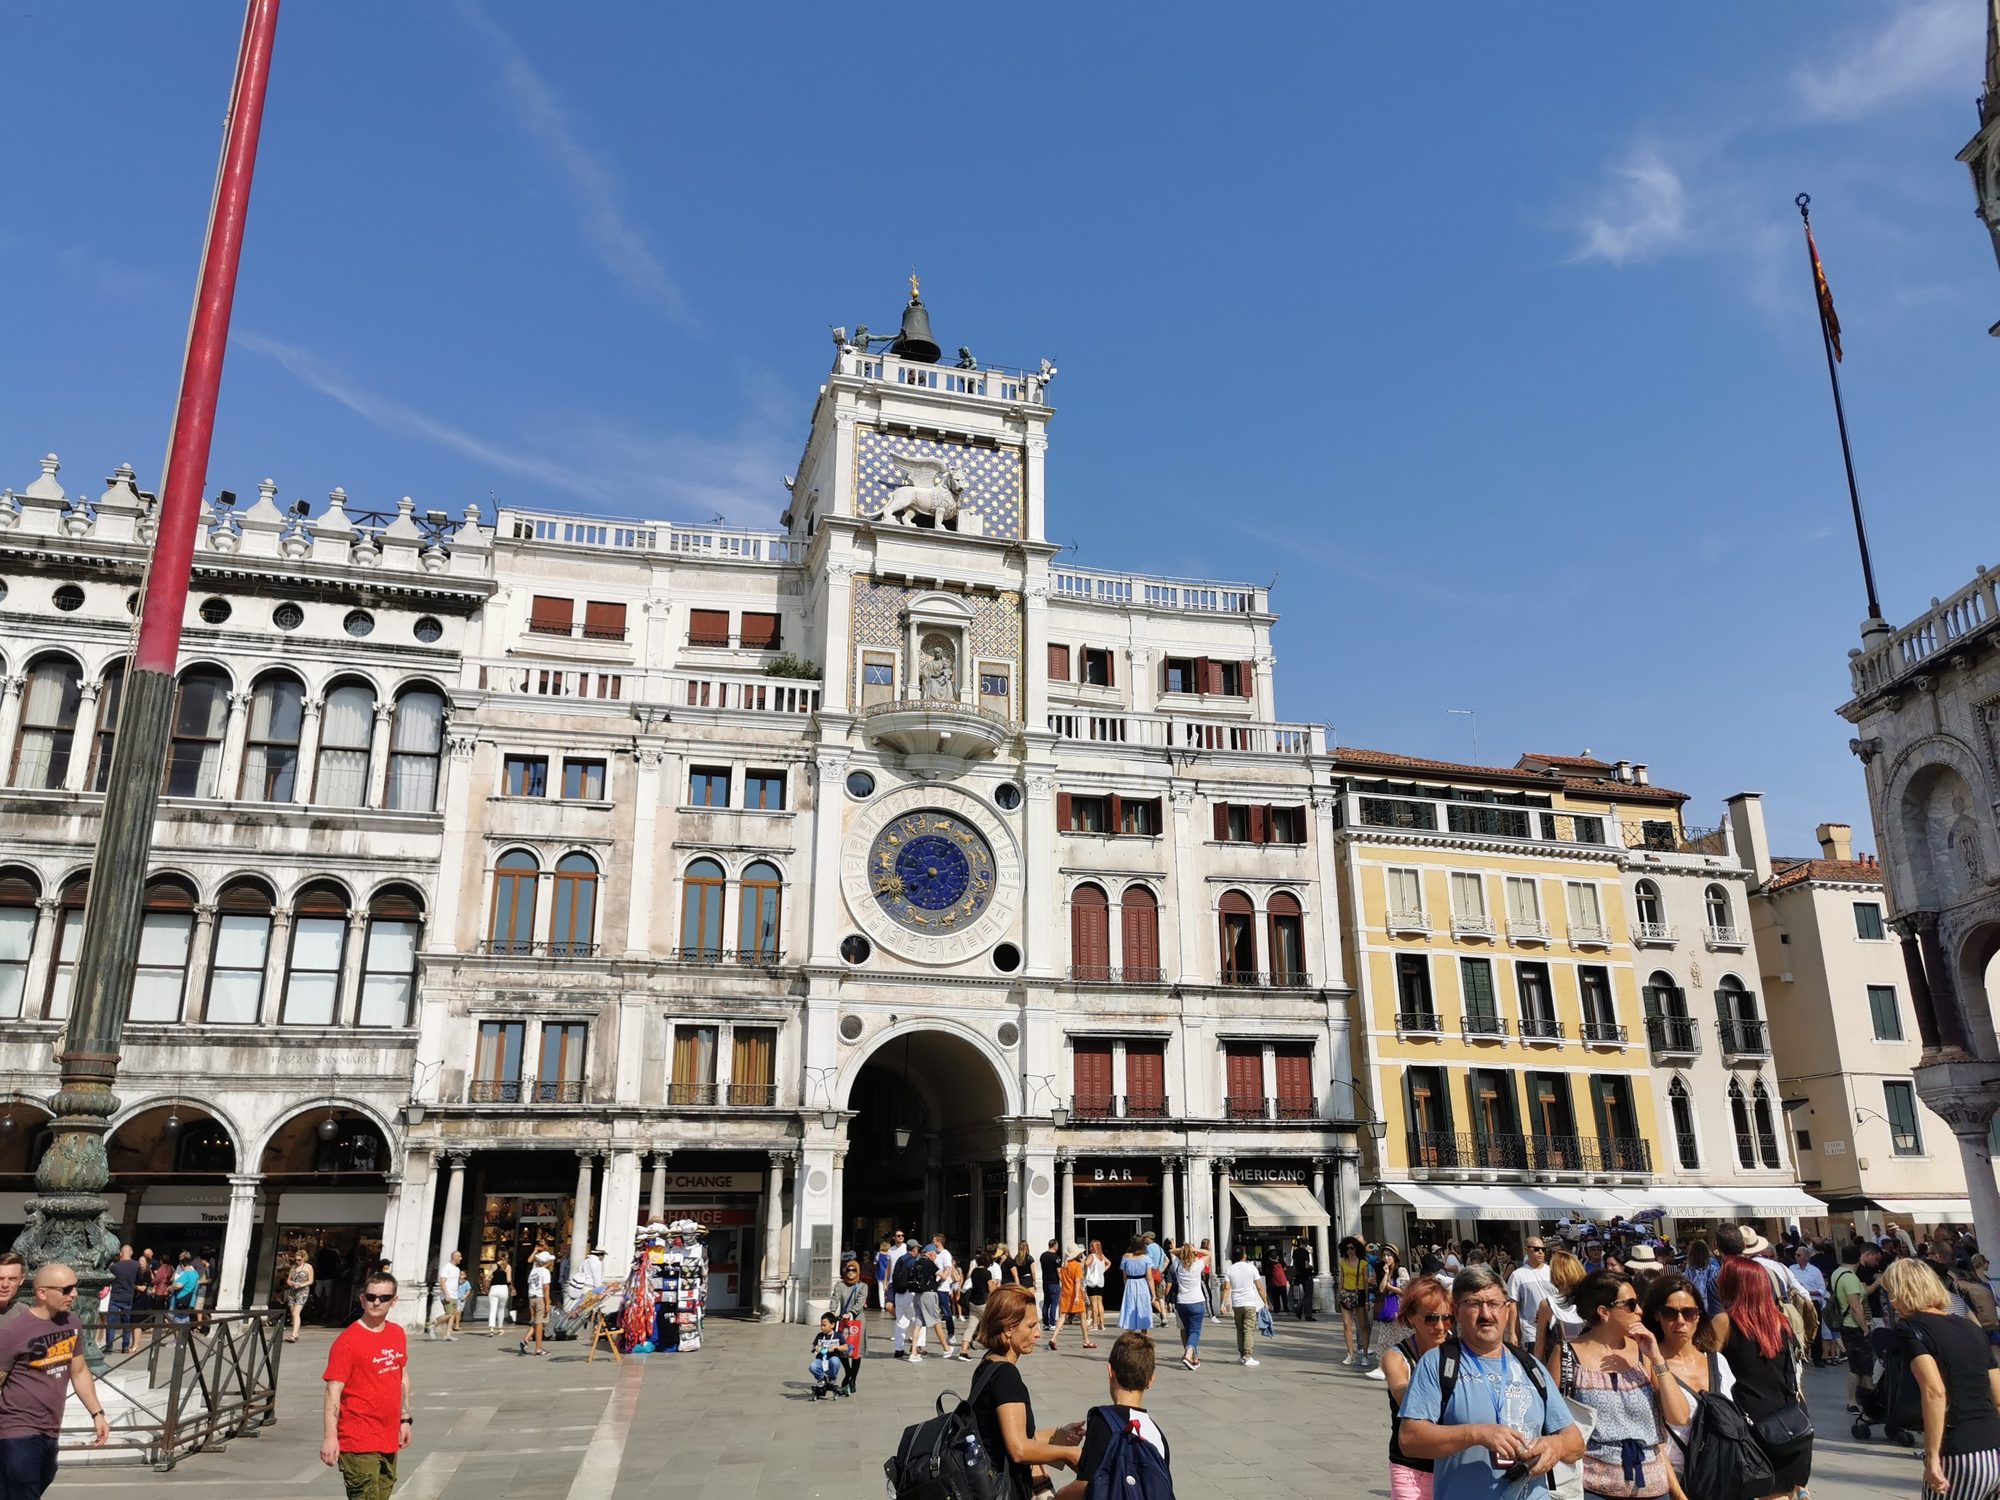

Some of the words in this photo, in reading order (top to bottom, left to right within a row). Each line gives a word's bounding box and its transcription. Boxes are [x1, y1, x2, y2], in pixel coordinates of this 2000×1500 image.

[872, 665, 884, 684] X
[271, 1055, 310, 1064] PIAZZA
[314, 1055, 338, 1064] SAN
[341, 1055, 379, 1064] MARCO
[1094, 1169, 1132, 1181] BAR
[1228, 1169, 1306, 1181] AMERICANO
[675, 1176, 733, 1188] CHANGE
[1471, 1209, 1503, 1218] ANTICA
[1547, 1209, 1585, 1218] VENEA
[1664, 1208, 1697, 1217] OUPOLE
[1751, 1207, 1761, 1216] LA
[1764, 1207, 1800, 1216] COUPOLE
